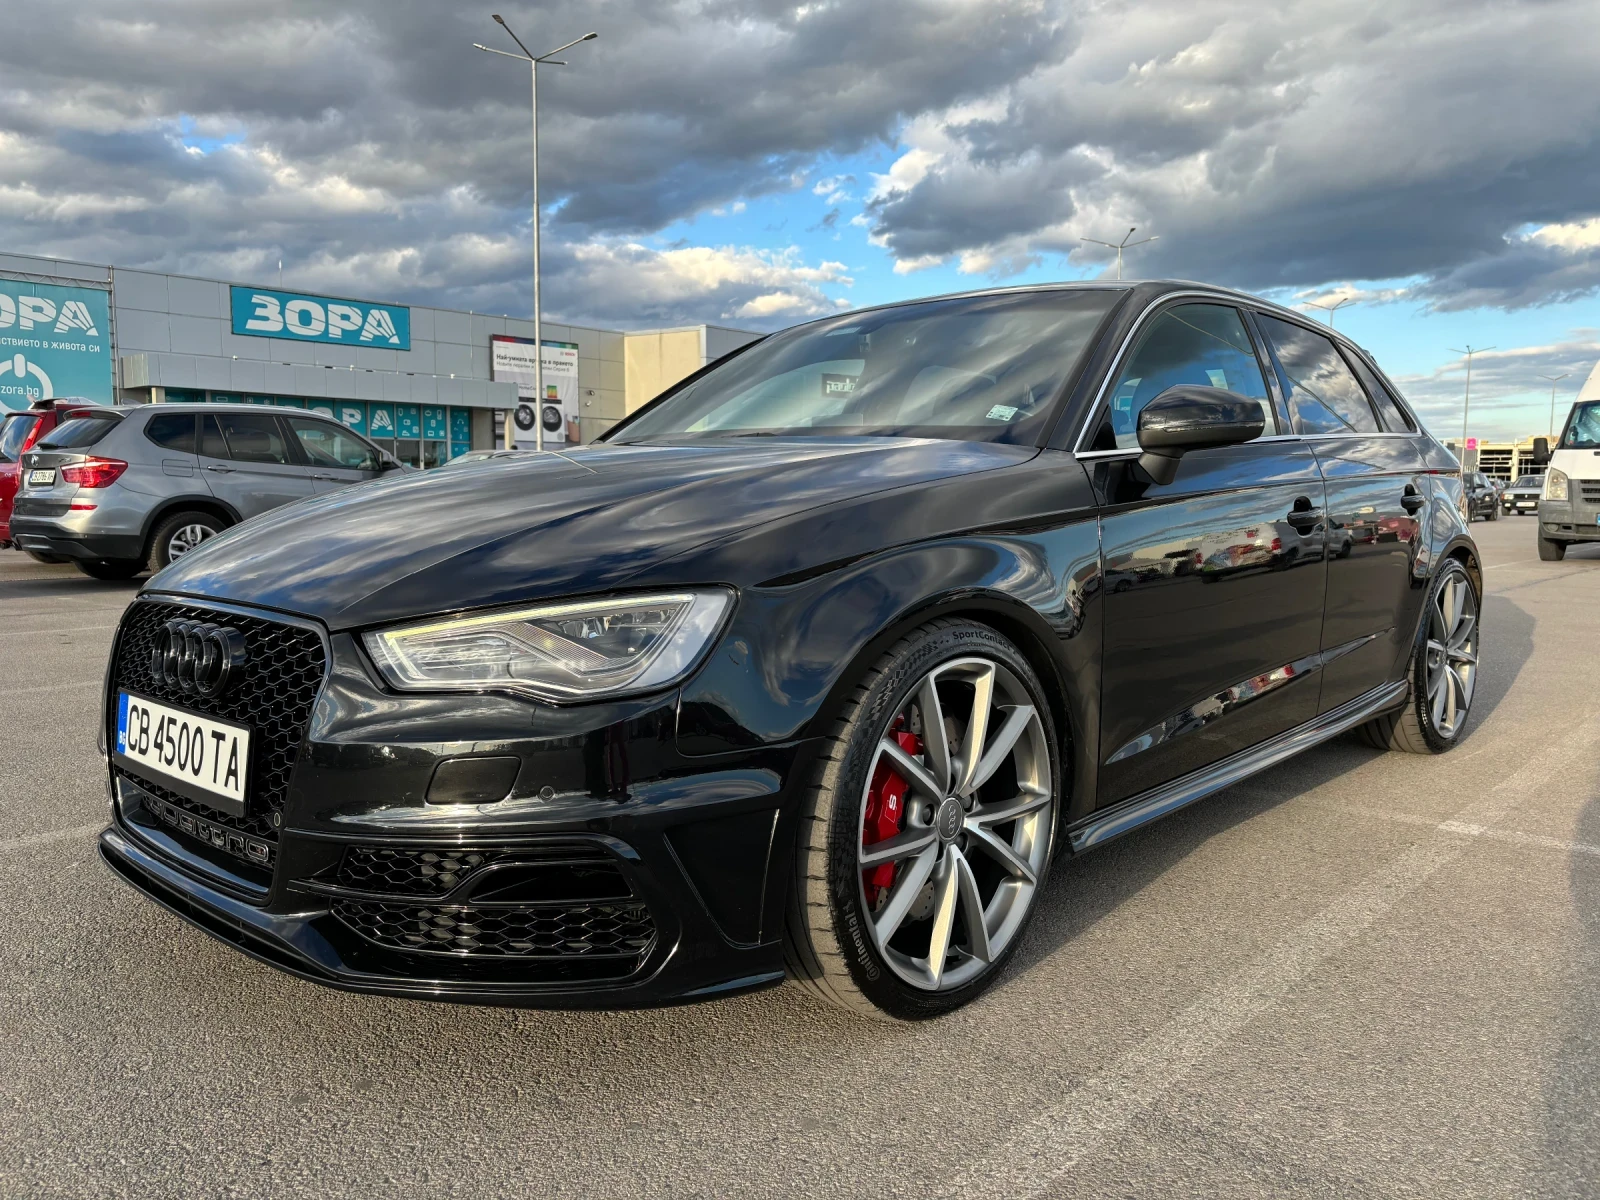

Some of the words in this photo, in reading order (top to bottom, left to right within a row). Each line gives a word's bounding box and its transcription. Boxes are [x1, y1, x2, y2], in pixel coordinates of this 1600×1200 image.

[246, 294, 400, 344] ЗОРА
[0, 338, 40, 347] ствието
[51, 341, 86, 351] живота
[89, 344, 100, 353] си
[497, 354, 527, 362] Най-умната
[1, 385, 39, 397] zora.bg
[119, 730, 126, 745] BG
[128, 704, 150, 756] CB
[153, 714, 204, 777] 4500
[211, 729, 239, 792] TA
[889, 793, 897, 811] S
[143, 795, 269, 862] quattro
[845, 912, 880, 981] Continental
